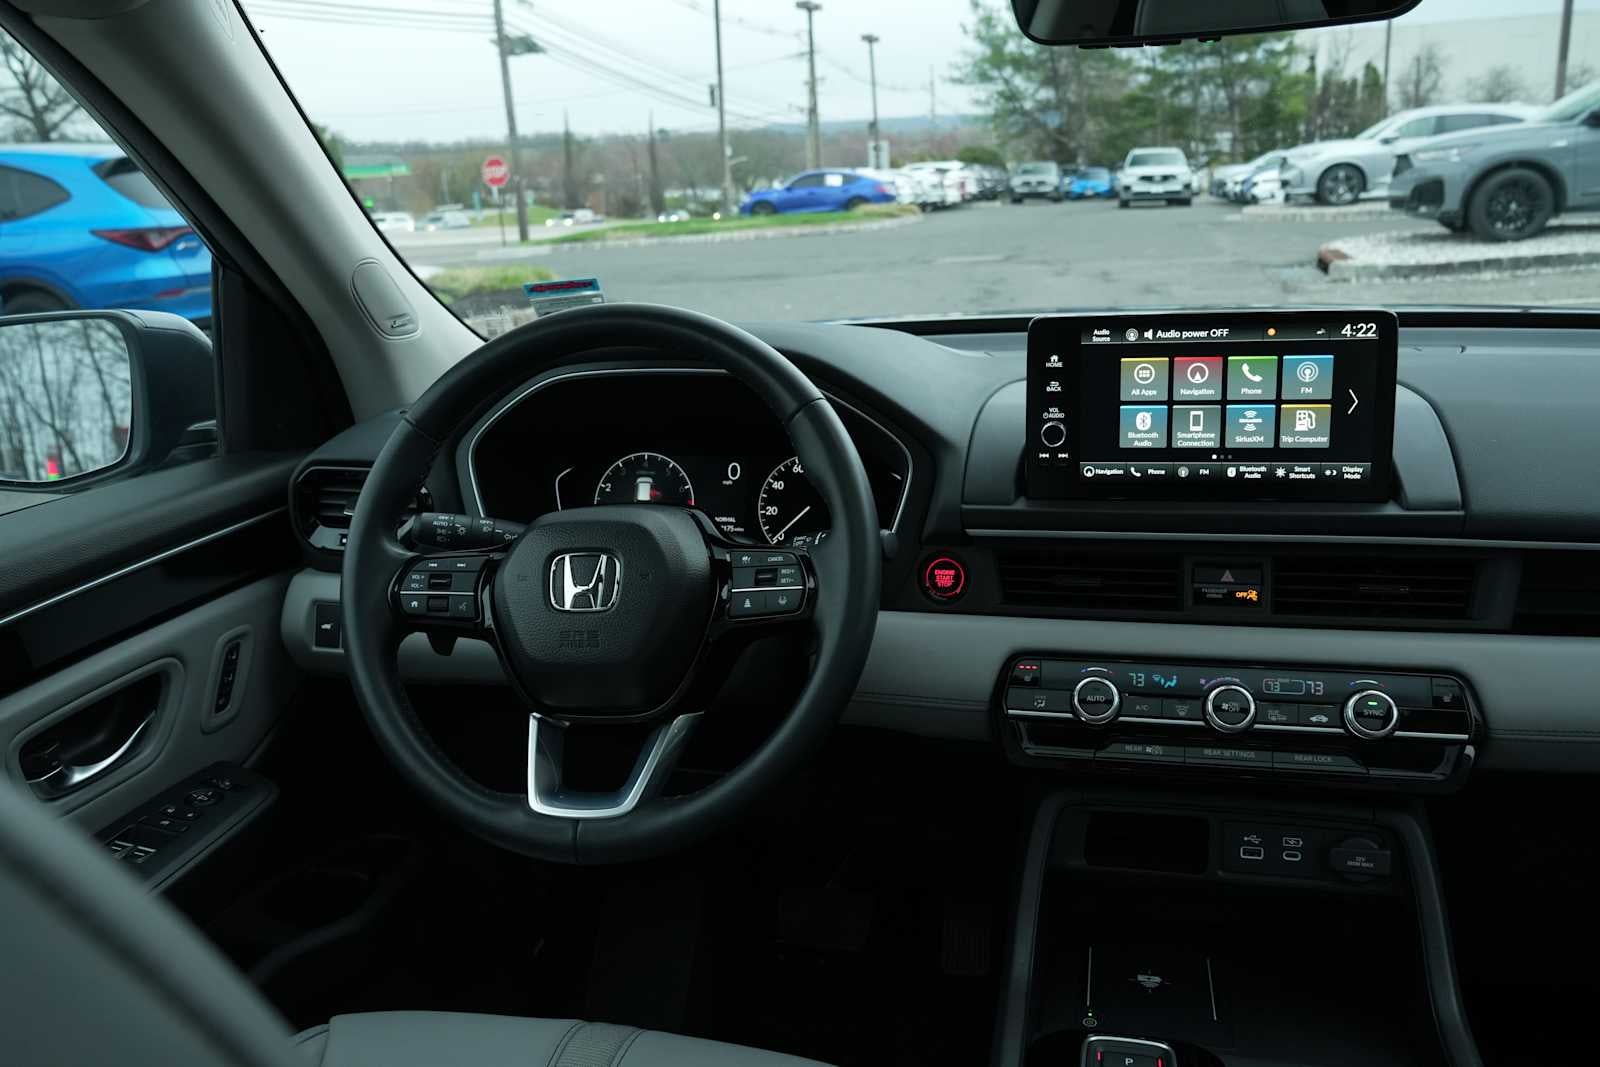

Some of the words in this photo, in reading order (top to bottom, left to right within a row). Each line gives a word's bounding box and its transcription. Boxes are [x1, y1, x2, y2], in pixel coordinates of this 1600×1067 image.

[1092, 328, 1110, 336] Audio
[1156, 329, 1181, 338] Audio
[1182, 330, 1209, 340] power
[1210, 328, 1229, 337] OFF
[1340, 323, 1377, 337] 4:22
[1092, 335, 1111, 343] Source
[1131, 388, 1140, 396] All
[1141, 388, 1157, 397] Apps
[1180, 387, 1215, 397] Navigation
[1241, 387, 1263, 395] Phone
[1127, 431, 1159, 439] Bluetooth
[1176, 431, 1216, 440] Smartphone
[1234, 435, 1265, 443] SiriusXM
[1281, 435, 1294, 444] Trip
[1294, 435, 1328, 444] Computer
[1133, 439, 1152, 447] Audio
[727, 462, 741, 481] 0
[1095, 468, 1124, 476] Navigation
[1342, 466, 1364, 474] Display
[1288, 472, 1316, 480] Shortcuts
[604, 482, 612, 493] 2
[771, 480, 785, 491] 40
[765, 505, 779, 516] 20
[1235, 591, 1248, 599] OFF
[1128, 672, 1145, 687] 73
[1267, 681, 1281, 693] 73
[1305, 680, 1324, 696] 73
[1086, 694, 1106, 703] AUTO
[1223, 749, 1256, 760] SETTINGS
[1125, 1057, 1134, 1066] P
